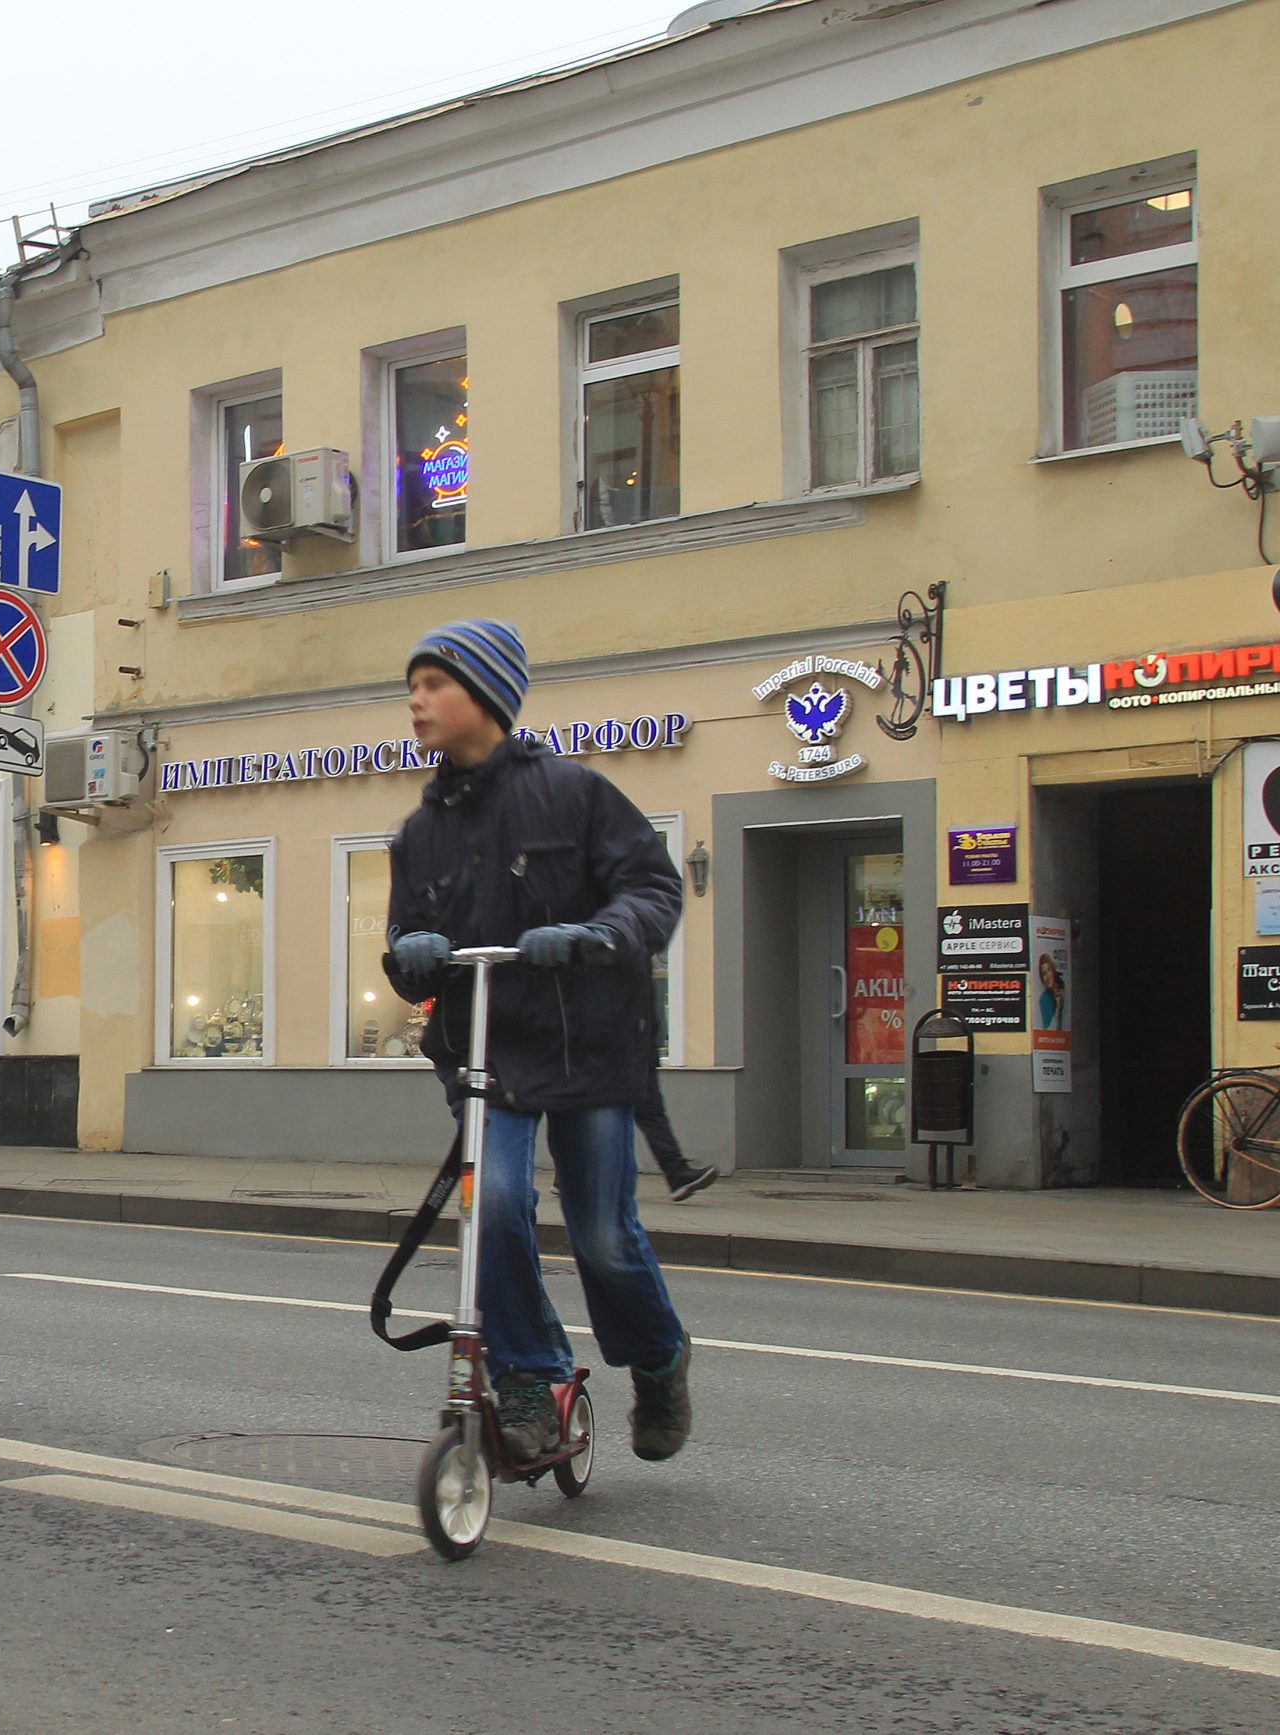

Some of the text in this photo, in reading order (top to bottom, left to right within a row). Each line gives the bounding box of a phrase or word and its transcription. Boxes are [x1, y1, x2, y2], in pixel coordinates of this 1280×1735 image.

[423, 454, 468, 474] МАГАЗИ
[1104, 643, 1280, 690] КОПИР
[752, 655, 881, 701] Imperial Porcelain
[933, 663, 1102, 722] ЦВЕТЫ
[1158, 681, 1280, 705] КОПИРОВАЛЬНЫ
[798, 745, 830, 764] 1744
[1251, 845, 1280, 858] РЕ
[1249, 864, 1280, 875] АКС
[968, 918, 1022, 931] iMastera
[946, 940, 1017, 951] APPLE СЕРВИС
